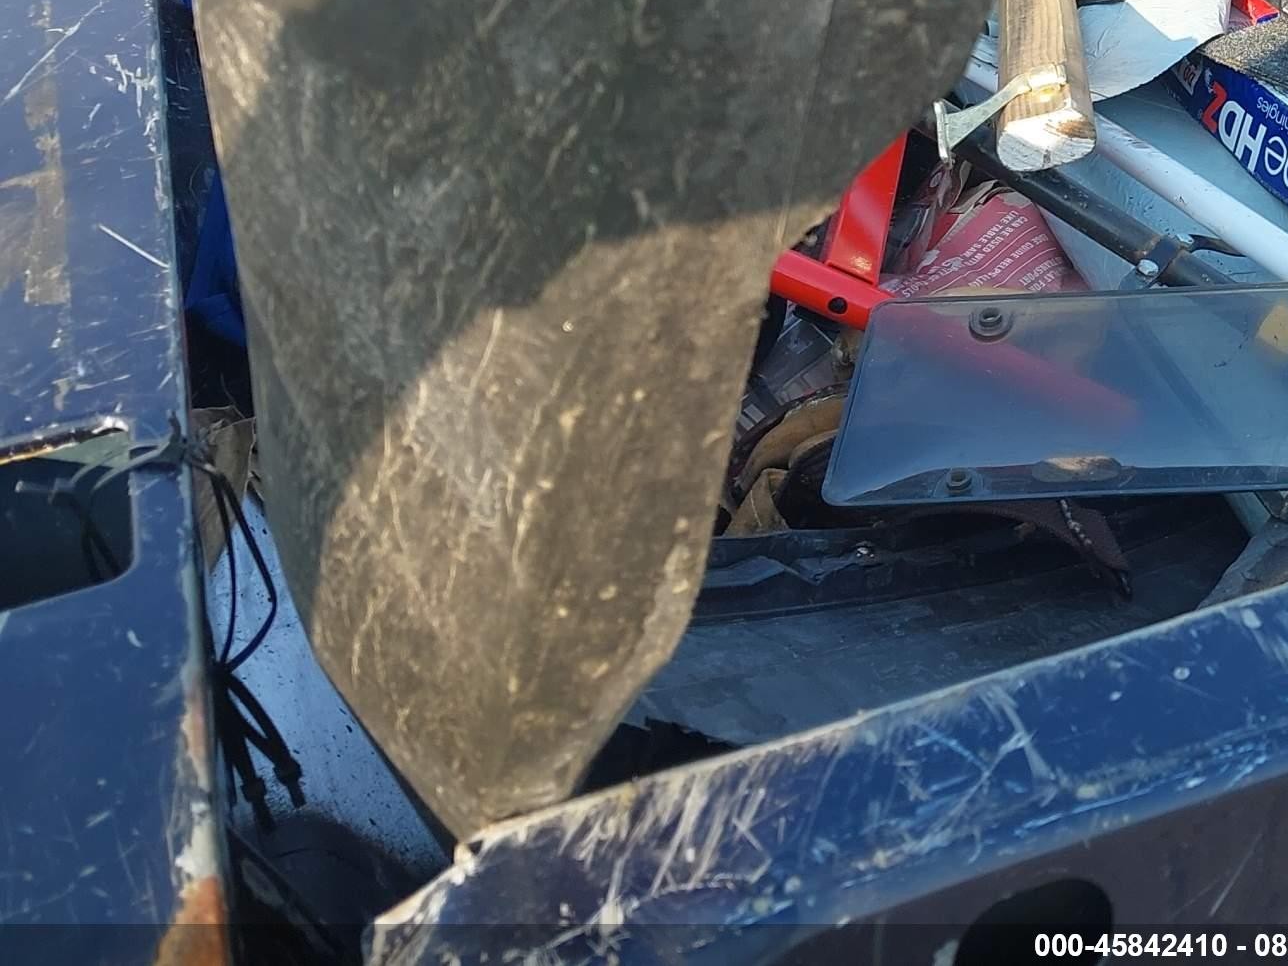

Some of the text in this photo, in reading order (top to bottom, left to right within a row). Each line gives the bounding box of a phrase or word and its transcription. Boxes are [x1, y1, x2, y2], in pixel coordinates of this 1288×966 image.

[1000, 210, 1019, 224] LIKE
[1011, 216, 1029, 228] CAN
[978, 223, 1004, 243] TABLE
[1000, 226, 1014, 237] BE
[982, 236, 1005, 253] USED
[988, 241, 1034, 277] GUIDE HELPS
